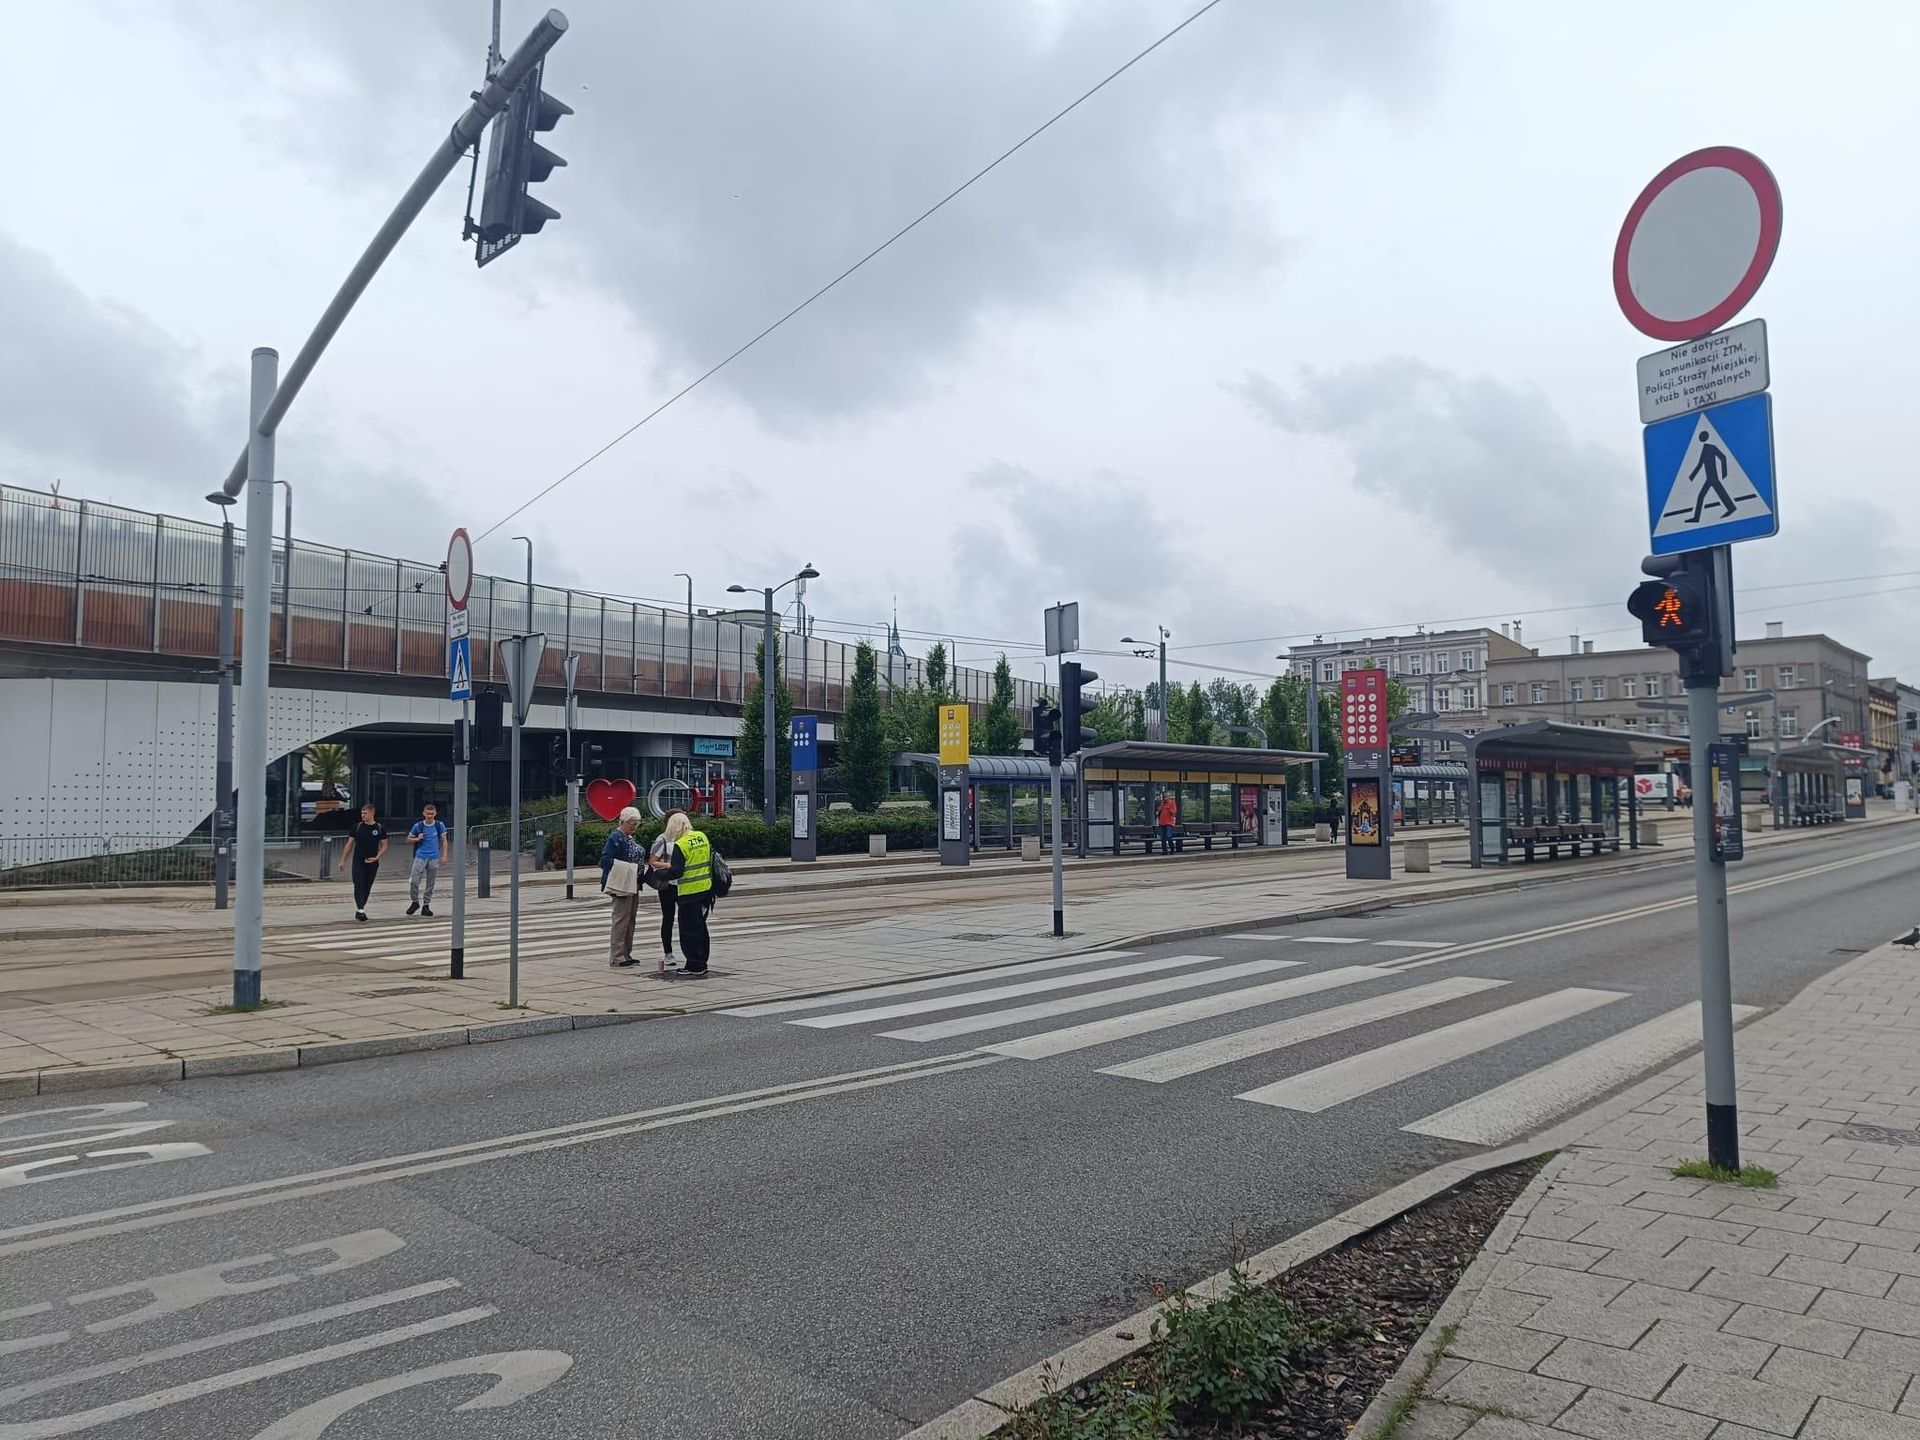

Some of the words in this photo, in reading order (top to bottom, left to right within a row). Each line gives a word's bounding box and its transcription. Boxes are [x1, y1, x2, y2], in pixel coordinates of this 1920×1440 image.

[1671, 350, 1688, 360] Nie
[1691, 336, 1729, 353] dotyczy
[1659, 350, 1718, 377] komunikacji
[1655, 390, 1680, 405] służb
[1683, 368, 1751, 396] komunalnych
[1693, 391, 1717, 406] TAXI
[687, 835, 705, 846] ZTM
